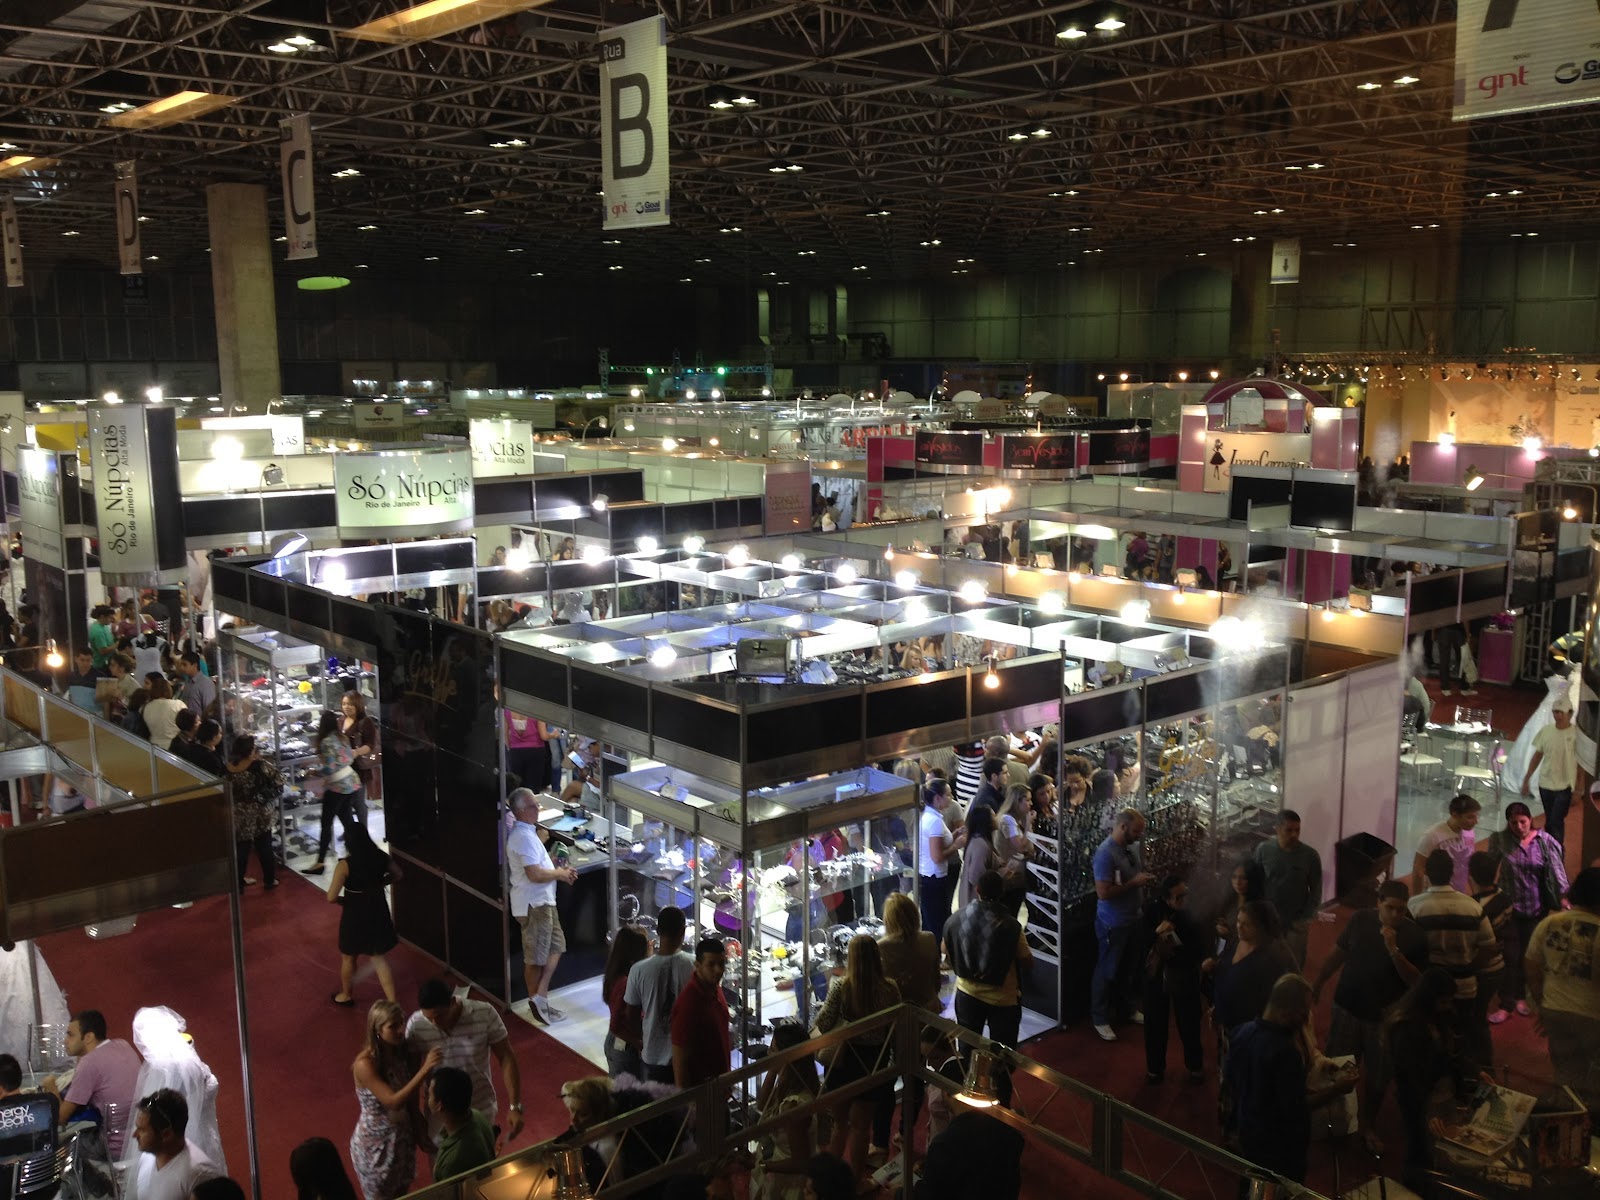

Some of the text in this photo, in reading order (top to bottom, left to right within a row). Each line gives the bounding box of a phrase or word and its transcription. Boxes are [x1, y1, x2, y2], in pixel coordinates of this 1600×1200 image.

[602, 44, 622, 59] Rua
[1478, 65, 1529, 99] gnt
[610, 72, 654, 181] B
[288, 149, 312, 225] C
[119, 189, 137, 246] D
[101, 424, 131, 555] Só Núpcias
[126, 487, 138, 547] Rio de Janeiro
[348, 473, 469, 506] Só Núpcias
[365, 501, 379, 509] Rio
[393, 500, 420, 508] Janeiro
